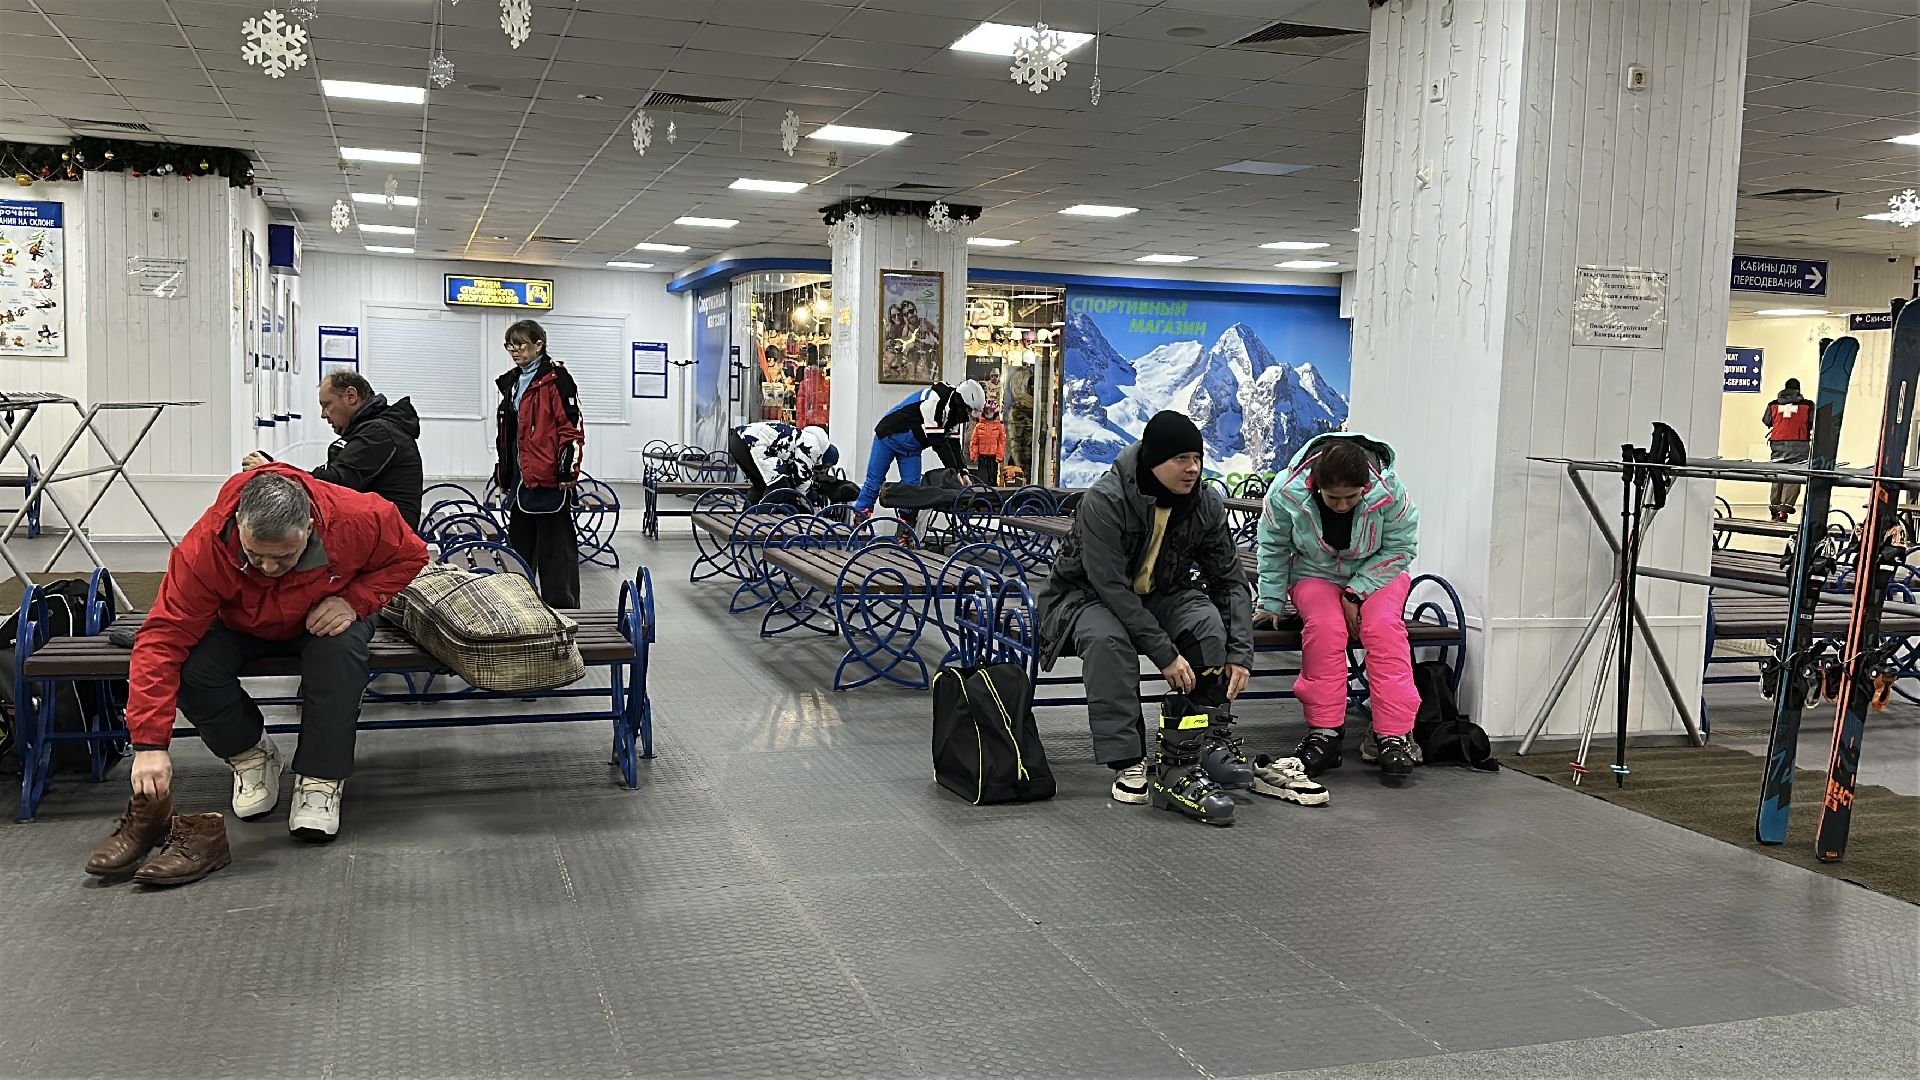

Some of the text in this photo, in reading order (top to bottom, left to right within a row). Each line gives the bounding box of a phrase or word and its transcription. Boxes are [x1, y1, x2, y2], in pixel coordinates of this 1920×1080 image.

[30, 219, 55, 227] СКЛОНЕ
[1740, 261, 1797, 275] КАБИНЫ ДЛЯ
[1733, 275, 1802, 289] ПЕРЕОДЕВАНИЯ
[1071, 297, 1188, 316] СПОРТИВНЫЙ
[1128, 318, 1207, 336] МАГАЗИН
